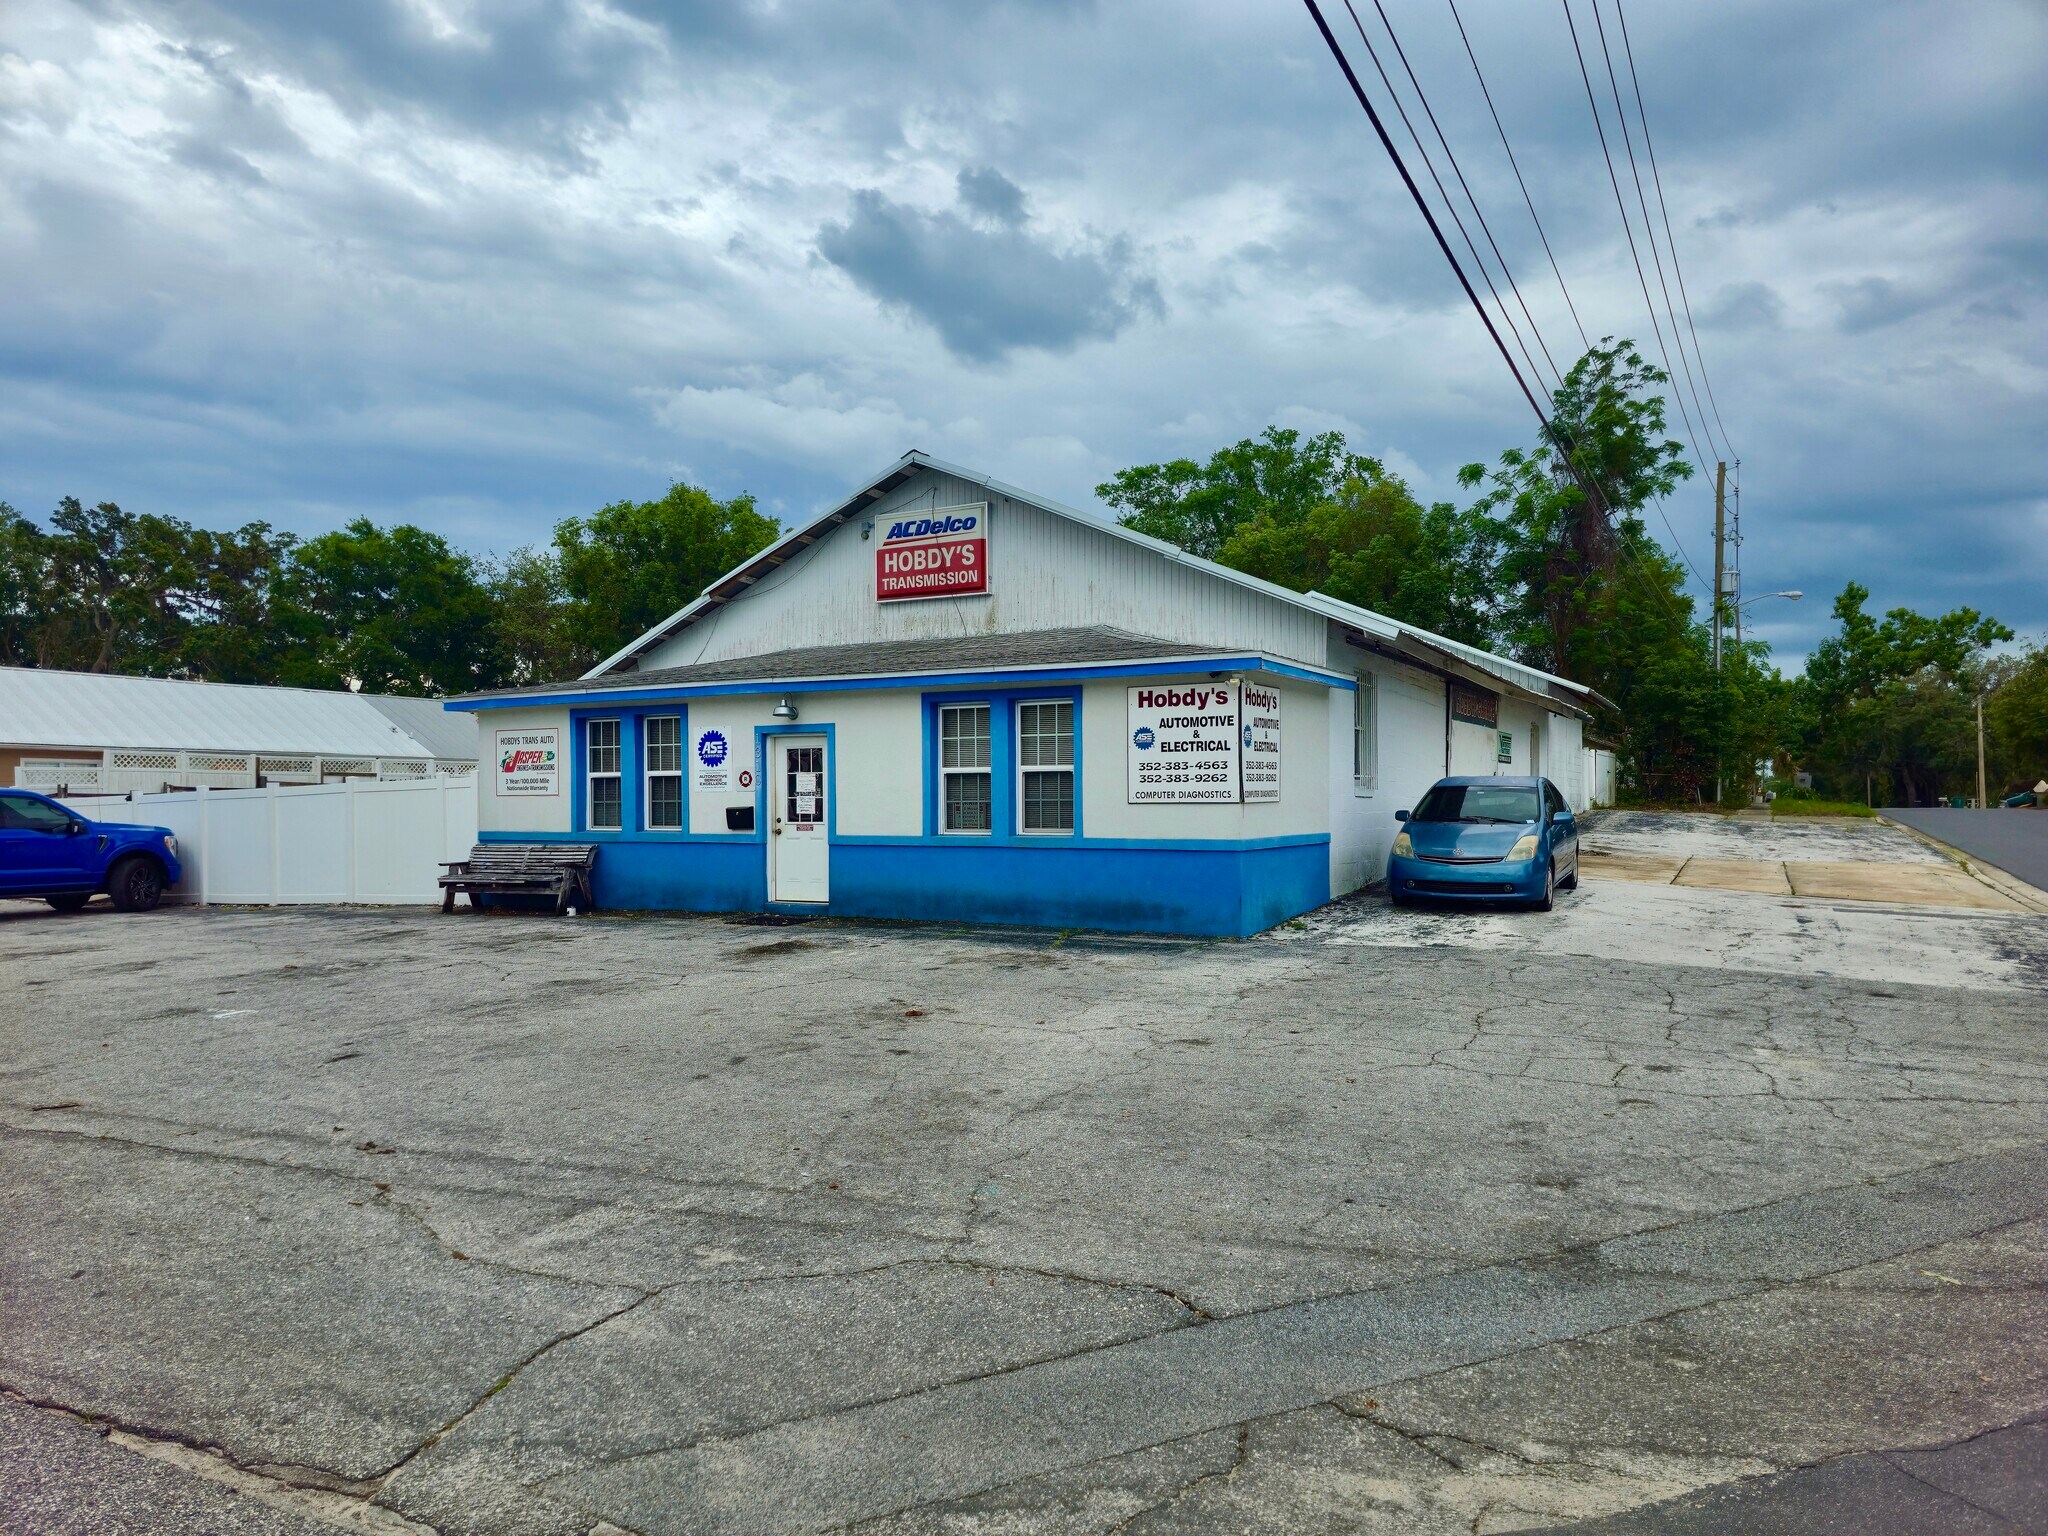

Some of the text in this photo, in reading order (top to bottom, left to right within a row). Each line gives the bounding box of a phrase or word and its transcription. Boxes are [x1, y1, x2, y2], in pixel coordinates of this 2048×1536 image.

[886, 515, 977, 540] ACDelco
[884, 544, 975, 574] HOBDY'S
[882, 569, 978, 591] TRANSMISSION
[1138, 687, 1229, 711] Hobdy's
[1245, 687, 1277, 713] Hobdy's
[1159, 715, 1235, 729] AUTOMOTIVE
[1253, 716, 1279, 730] AUTOMOTIVE
[500, 735, 555, 745] HOBDYS TRANS AUTO
[1135, 732, 1153, 741] ASE
[1193, 729, 1200, 739] &
[702, 741, 723, 755] ASE
[1160, 740, 1231, 753] ELECTRICAL
[1253, 740, 1279, 753] ELECTRICAL
[504, 750, 543, 773] JASPER
[1138, 760, 1228, 771] 352-383-4563
[1139, 773, 1228, 783] 352-383-9262
[1135, 790, 1232, 799] COMPUTER DIAGNOSTICS
